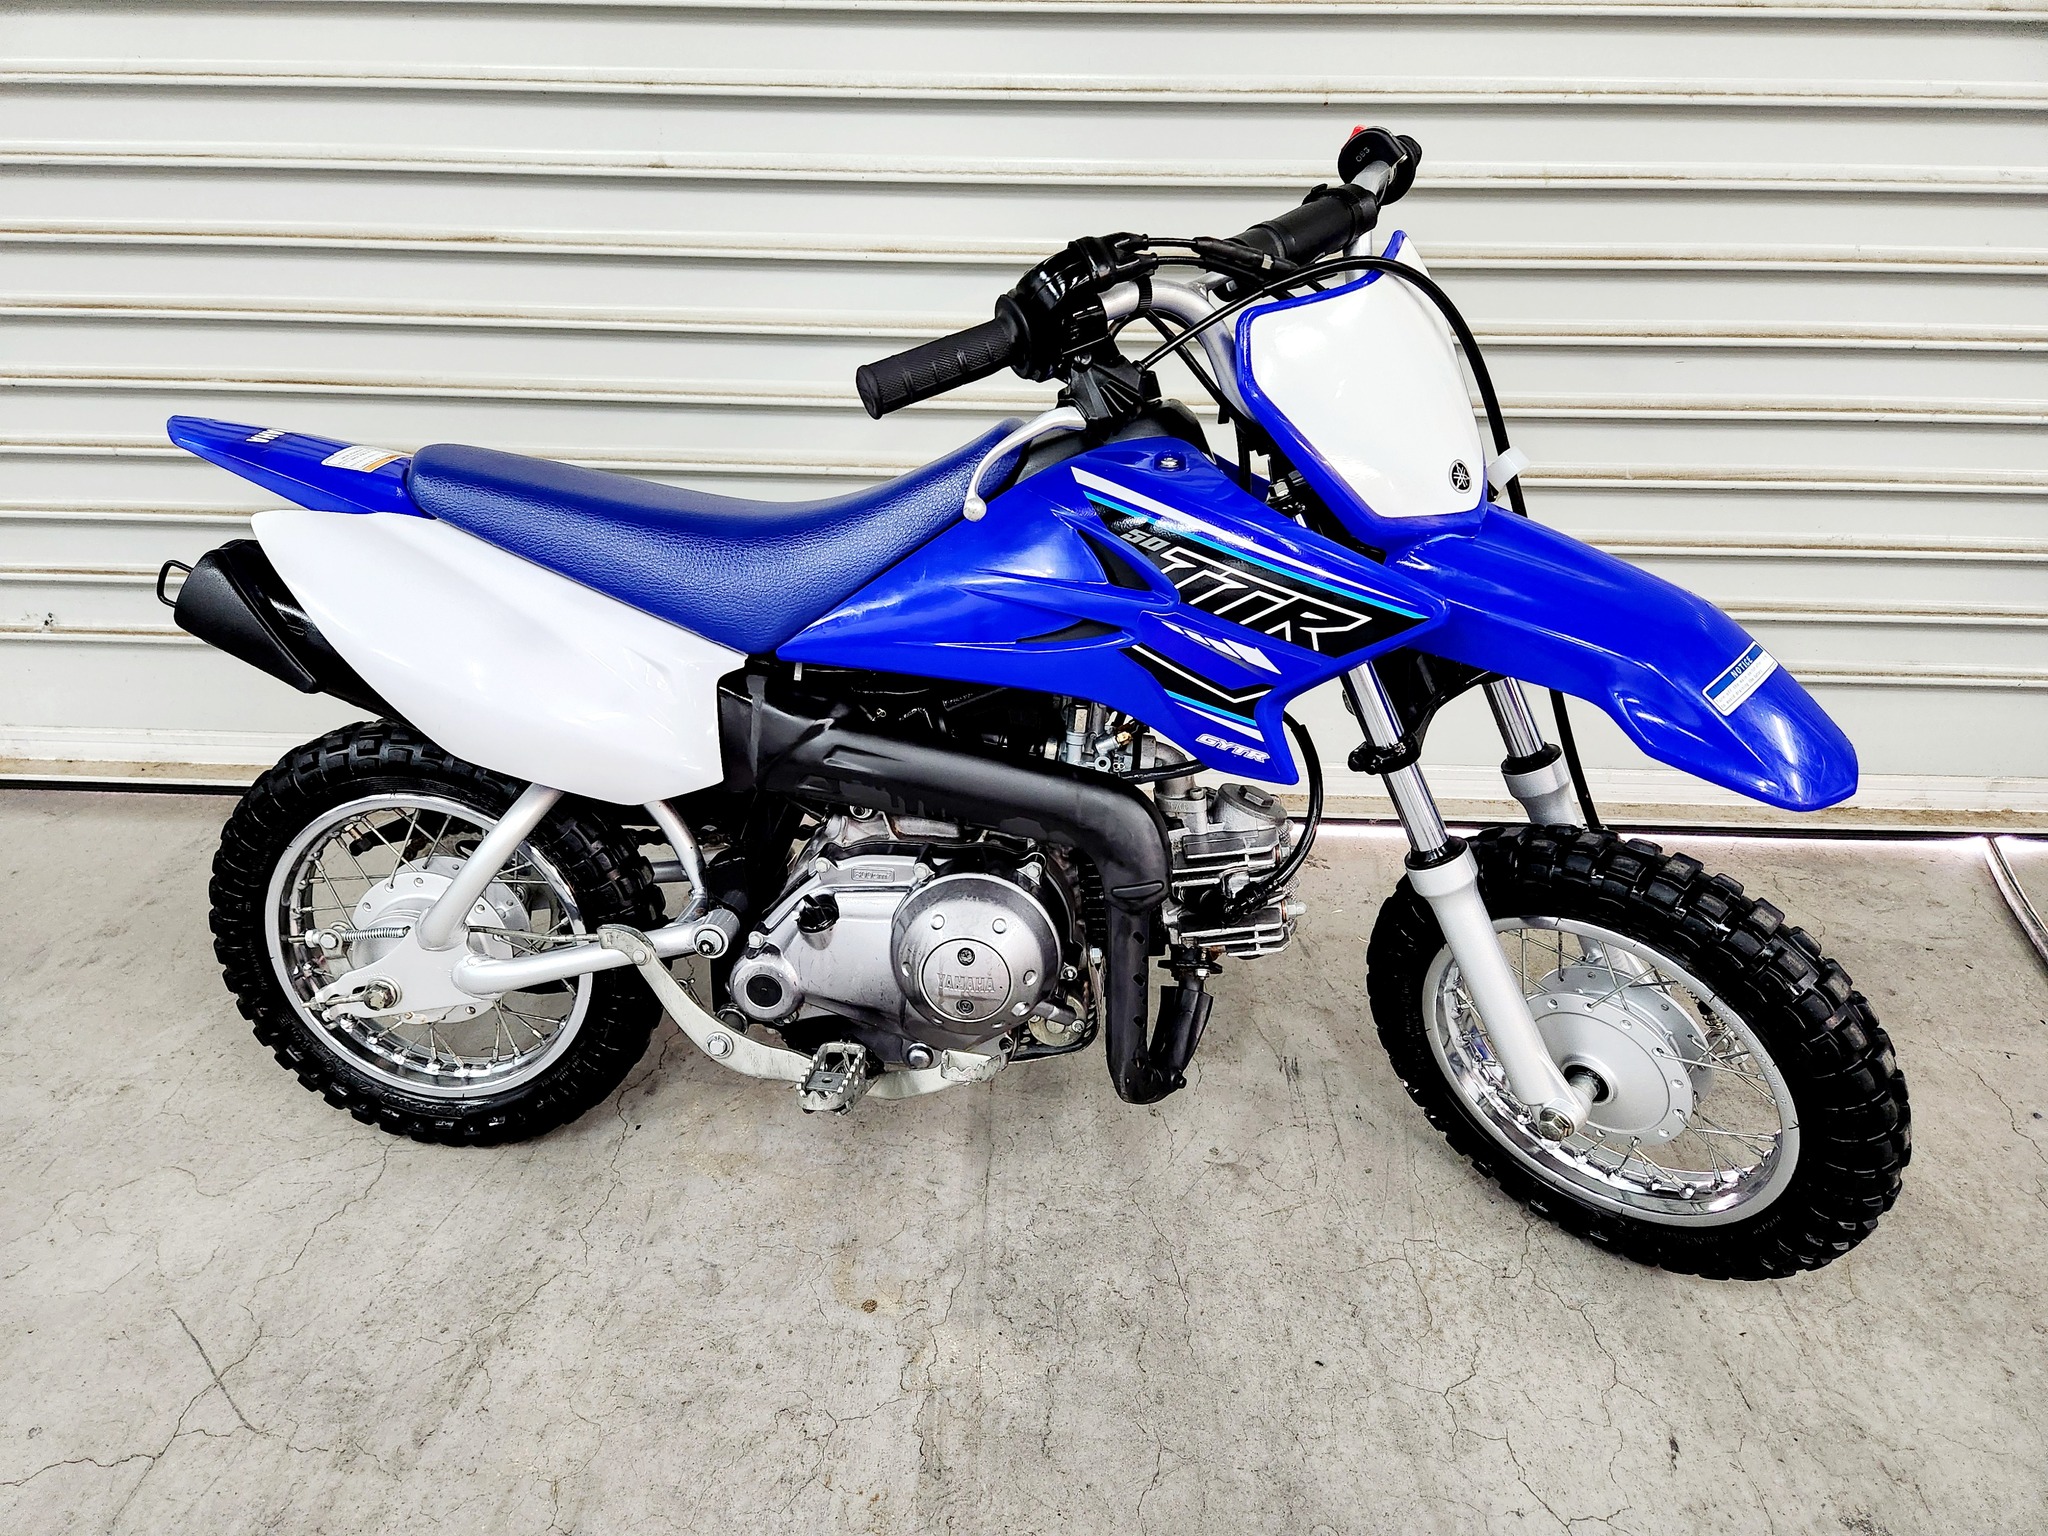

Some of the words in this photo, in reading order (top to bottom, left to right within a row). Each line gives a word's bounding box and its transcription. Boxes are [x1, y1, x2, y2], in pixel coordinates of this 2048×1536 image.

[1120, 528, 1171, 551] 50
[1160, 546, 1372, 652] TTR
[1729, 655, 1754, 679] NOTICE
[1195, 733, 1270, 764] GYTR
[936, 972, 995, 993] YAMAHA
